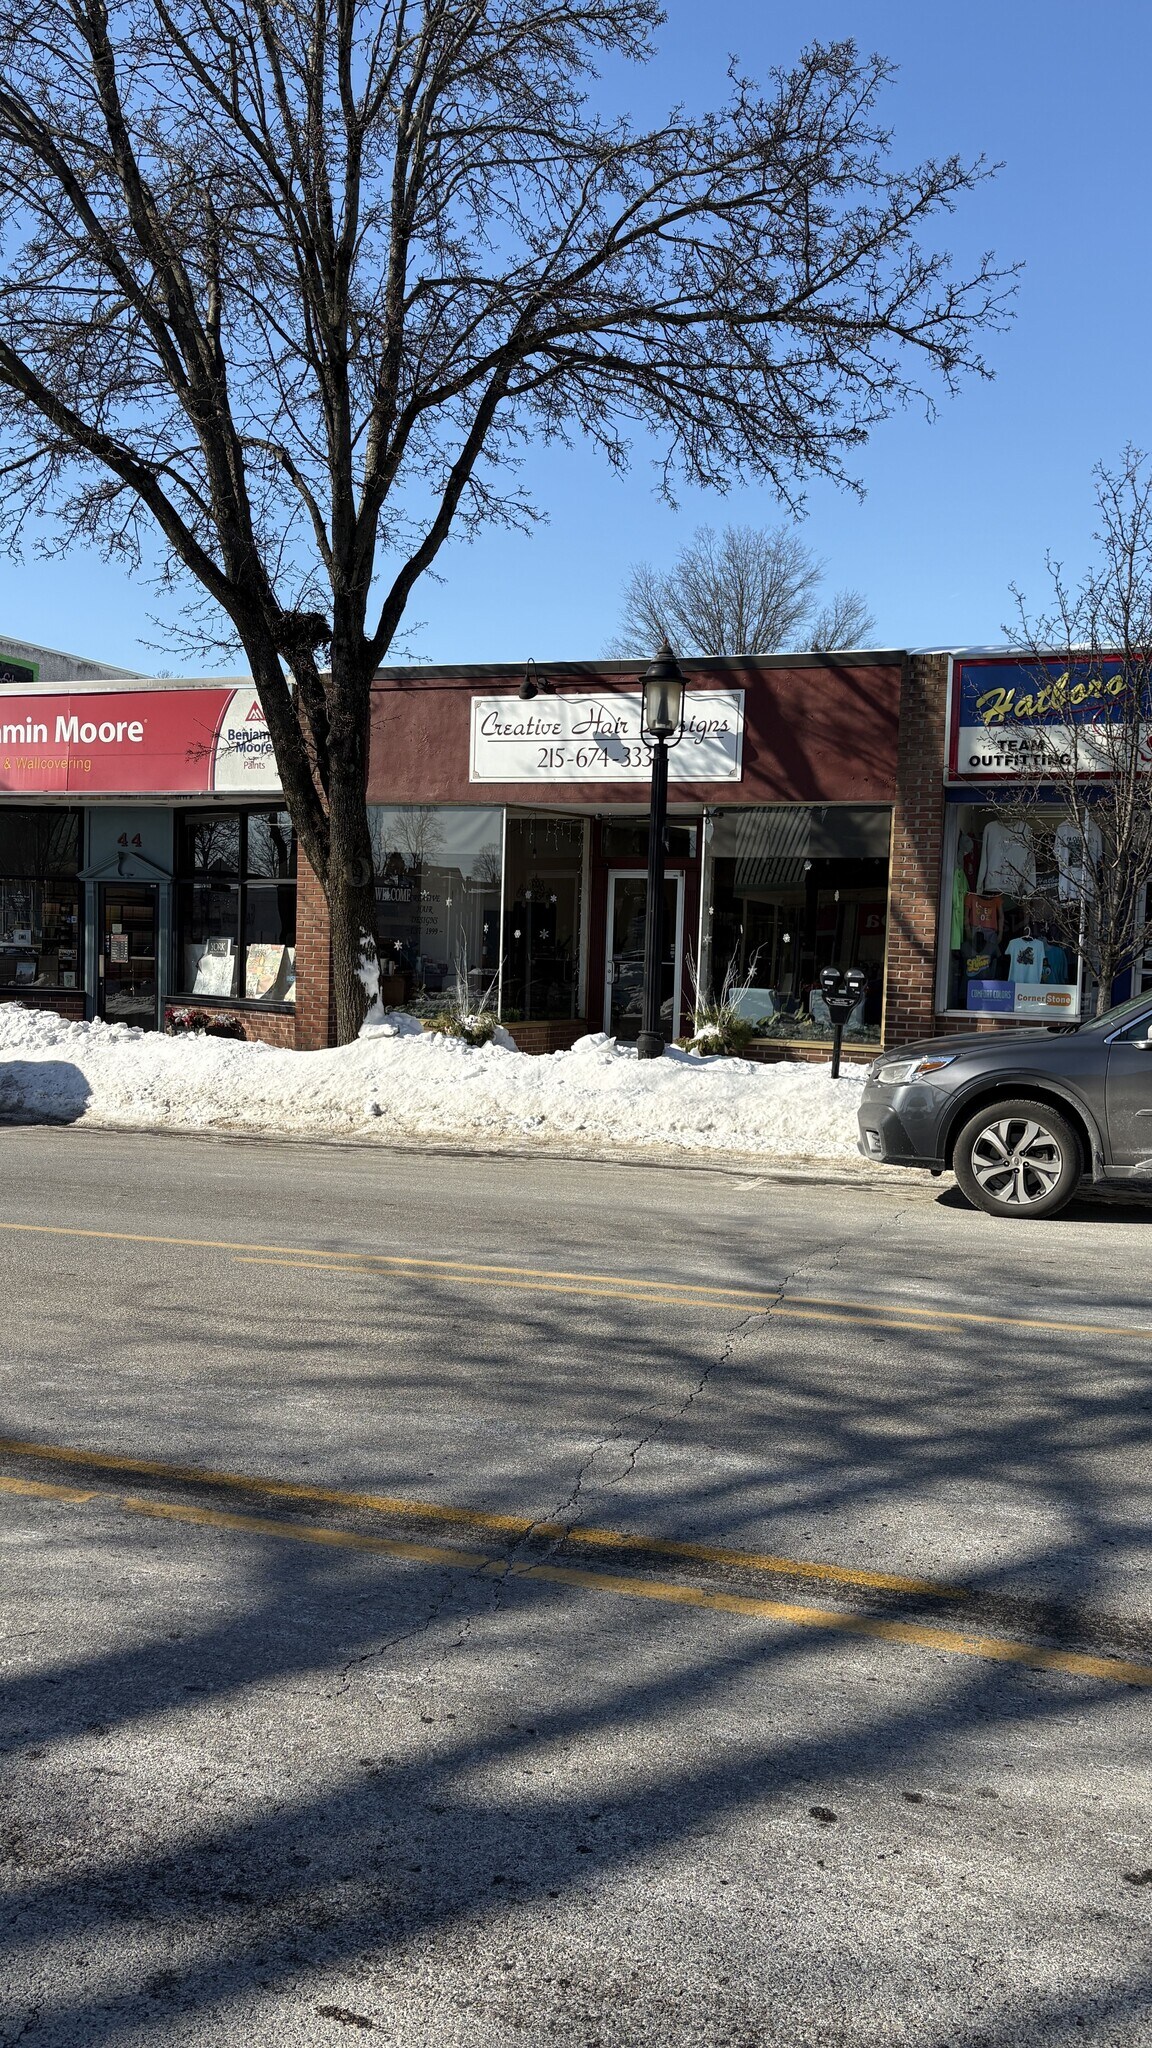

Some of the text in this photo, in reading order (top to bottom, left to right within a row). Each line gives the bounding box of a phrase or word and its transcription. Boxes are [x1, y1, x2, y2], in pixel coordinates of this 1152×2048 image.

[481, 711, 562, 737] Creative
[571, 705, 629, 736] Hair
[0, 715, 144, 744] min Moore
[236, 742, 272, 753] Moore
[997, 740, 1046, 752] TEAM
[4, 756, 92, 772] & Wallcovering
[243, 760, 266, 770] Paints
[537, 747, 652, 768] 215-674-333
[969, 753, 1072, 768] OUTFITTING
[117, 832, 142, 848] 44
[375, 887, 412, 902] WELCOME
[993, 990, 1012, 1000] COLORS
